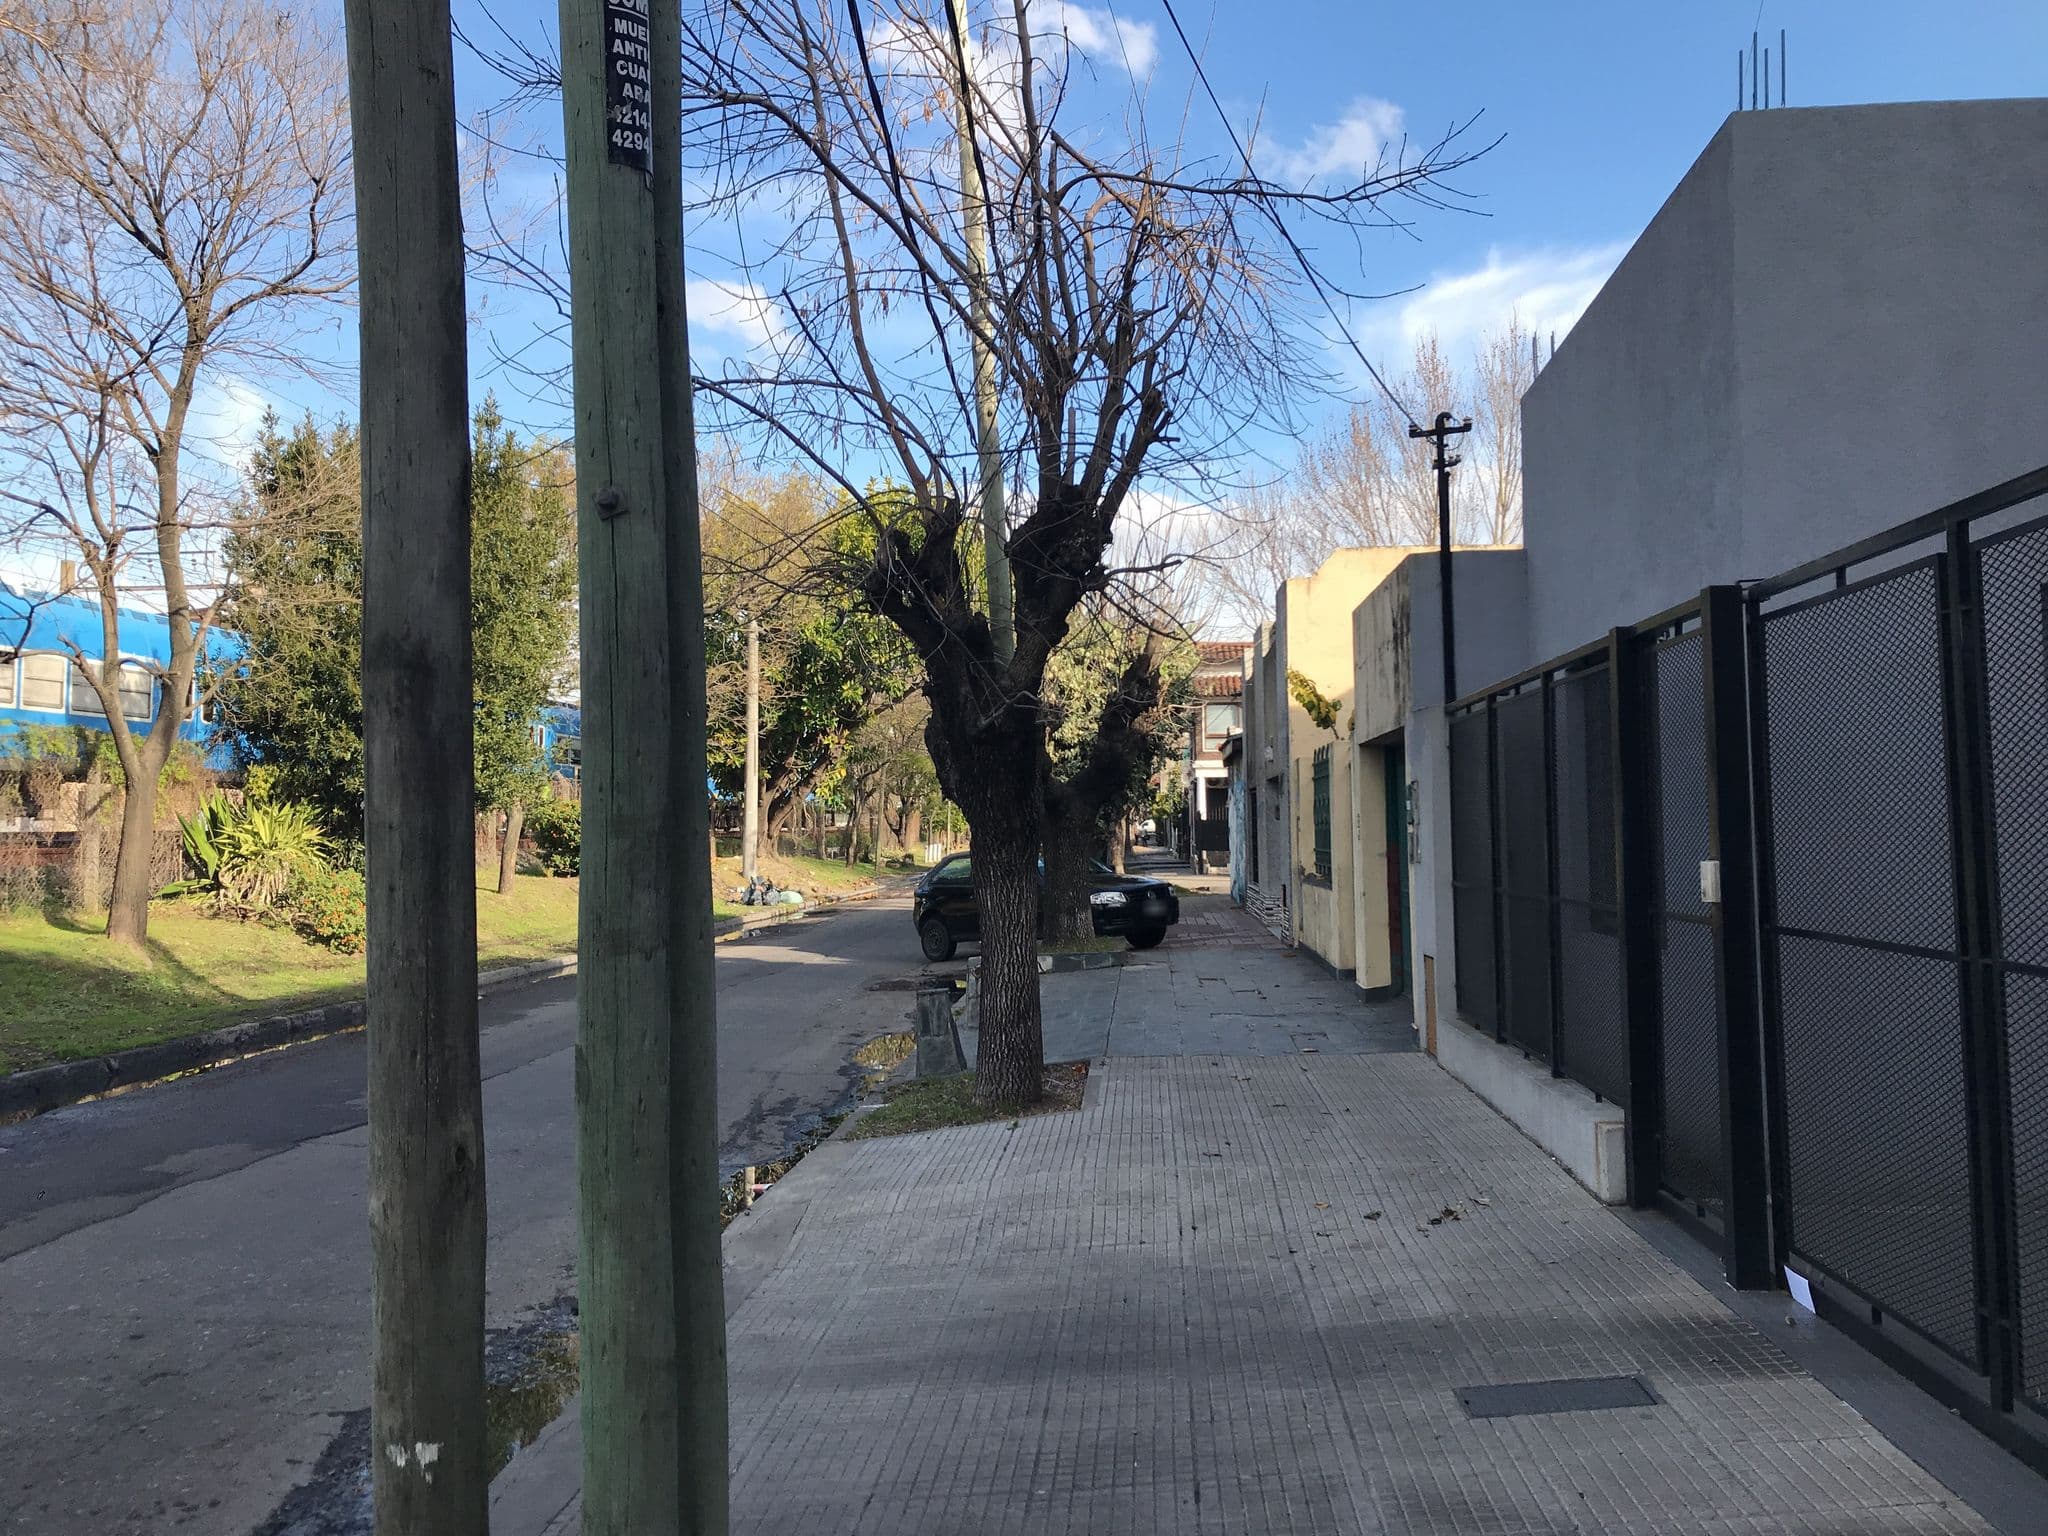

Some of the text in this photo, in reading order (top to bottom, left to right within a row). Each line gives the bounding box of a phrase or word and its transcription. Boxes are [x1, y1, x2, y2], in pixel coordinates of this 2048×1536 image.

[614, 18, 647, 41] MUE
[613, 39, 647, 62] ANTI
[616, 60, 647, 82] CUA
[612, 129, 649, 154] 4294
